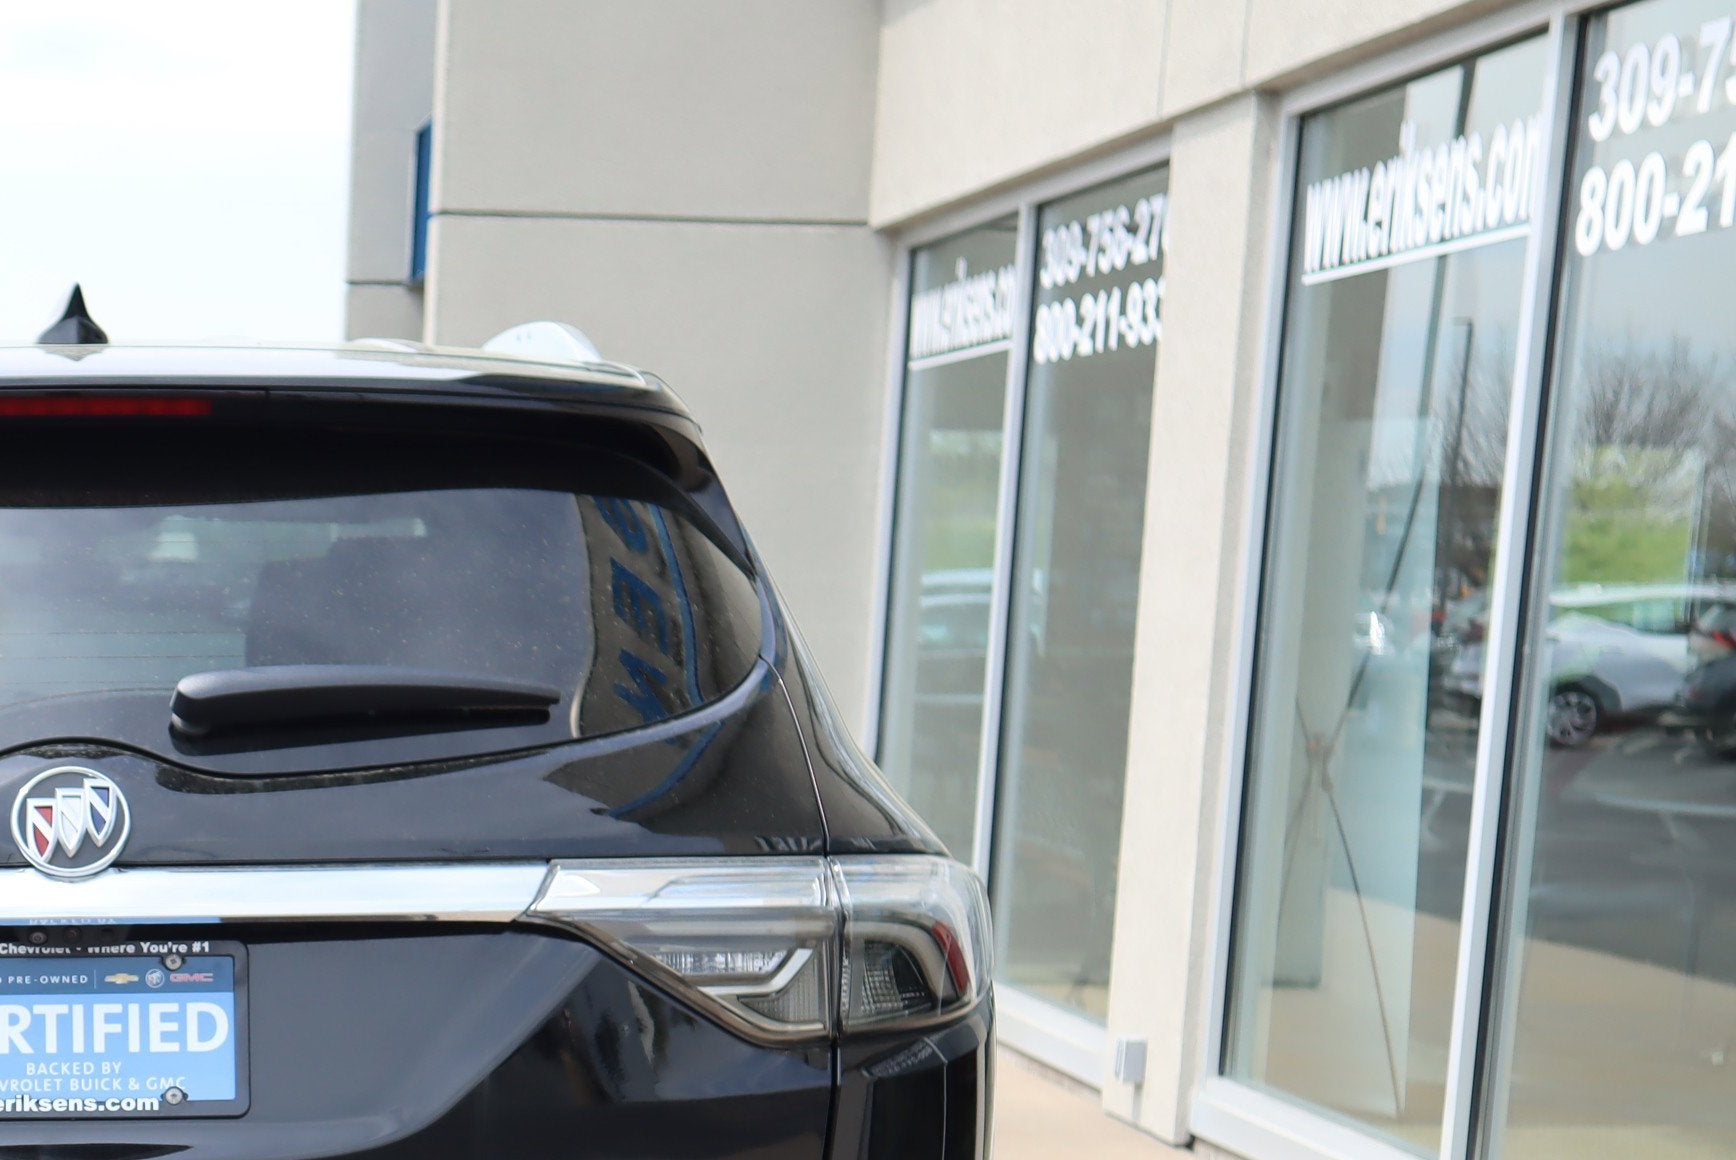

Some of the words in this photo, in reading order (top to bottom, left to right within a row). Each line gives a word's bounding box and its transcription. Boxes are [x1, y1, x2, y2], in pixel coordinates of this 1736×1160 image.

[140, 941, 188, 954] You're
[191, 940, 210, 953] #1
[26, 1061, 95, 1076] BACKED
[101, 1061, 122, 1075] BY
[69, 1077, 123, 1091] BUICK
[128, 1077, 140, 1091] &
[146, 1076, 187, 1090] GMC
